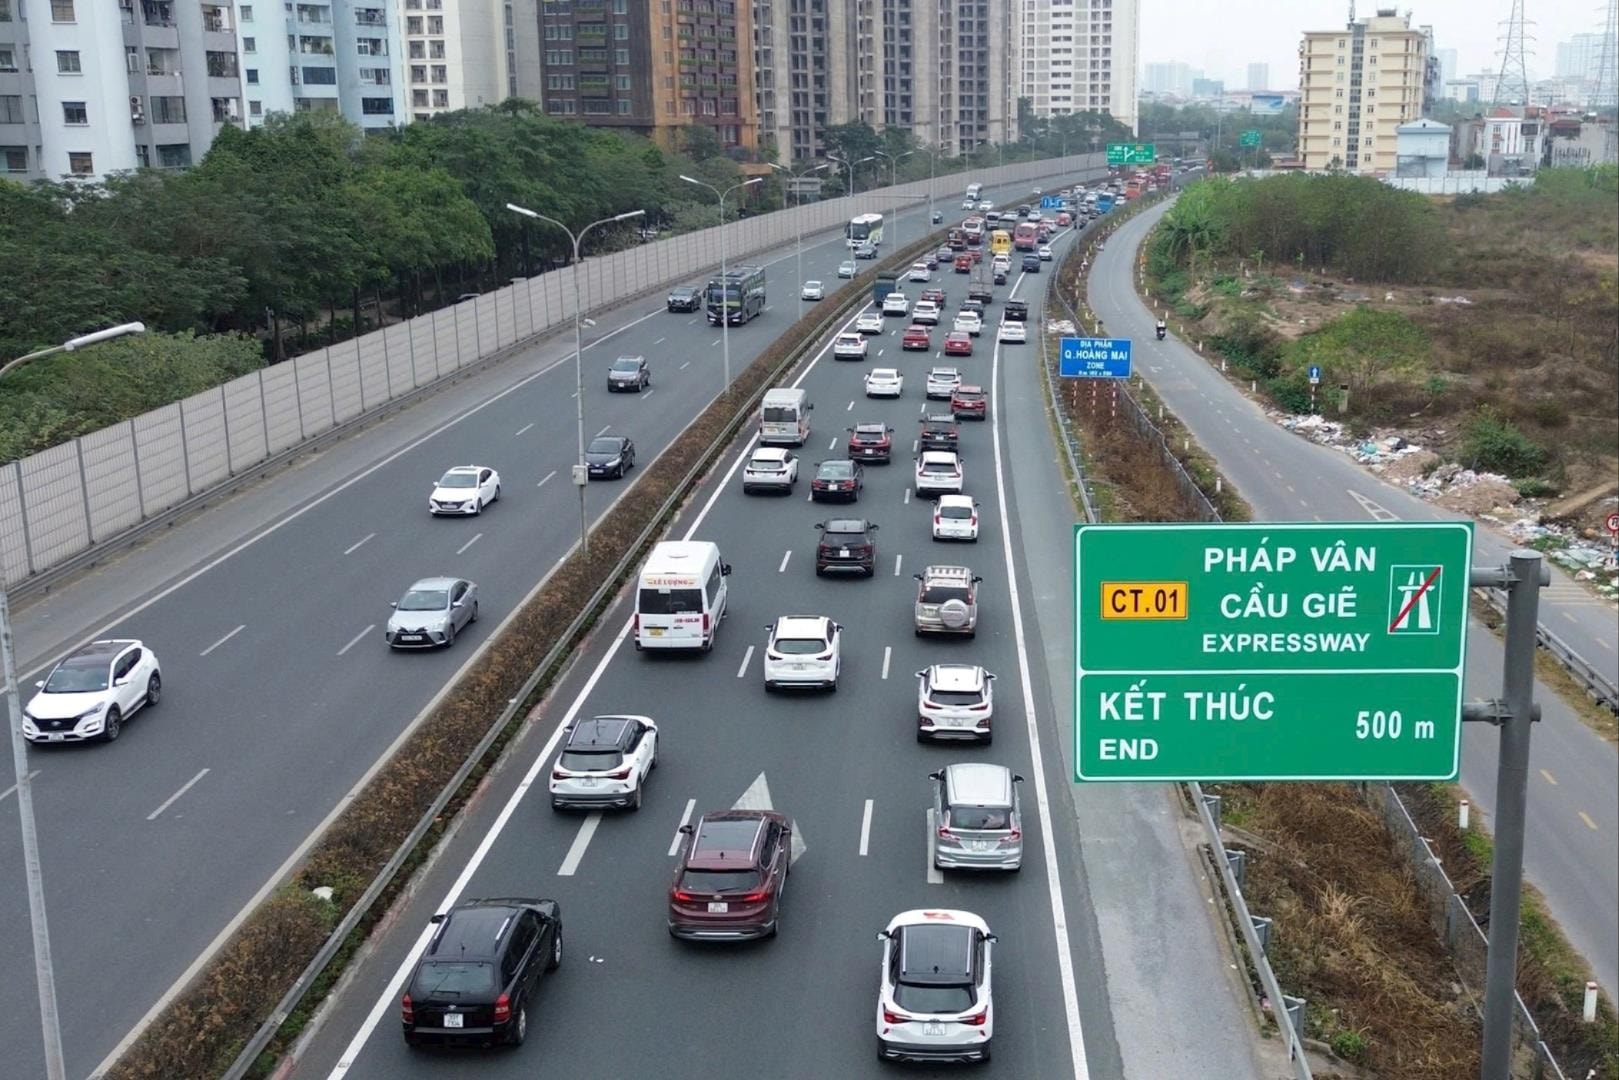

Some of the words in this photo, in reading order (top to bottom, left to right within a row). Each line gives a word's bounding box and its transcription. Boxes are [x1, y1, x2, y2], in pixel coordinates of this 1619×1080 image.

[1064, 349, 1108, 360] Q.HOÀNG
[1111, 351, 1128, 360] MAI
[1204, 537, 1297, 573] PHÁP
[1310, 539, 1376, 573] VÂN
[1111, 588, 1179, 614] CT.01
[1220, 581, 1288, 618] CẦU
[1302, 585, 1358, 618] GIẼ
[1202, 633, 1370, 653] EXPRESSWAY
[1100, 679, 1167, 721] KẾT
[1184, 683, 1275, 721] THÚC
[1356, 710, 1402, 739] 500
[1414, 720, 1435, 739] m
[1099, 738, 1159, 760] END
